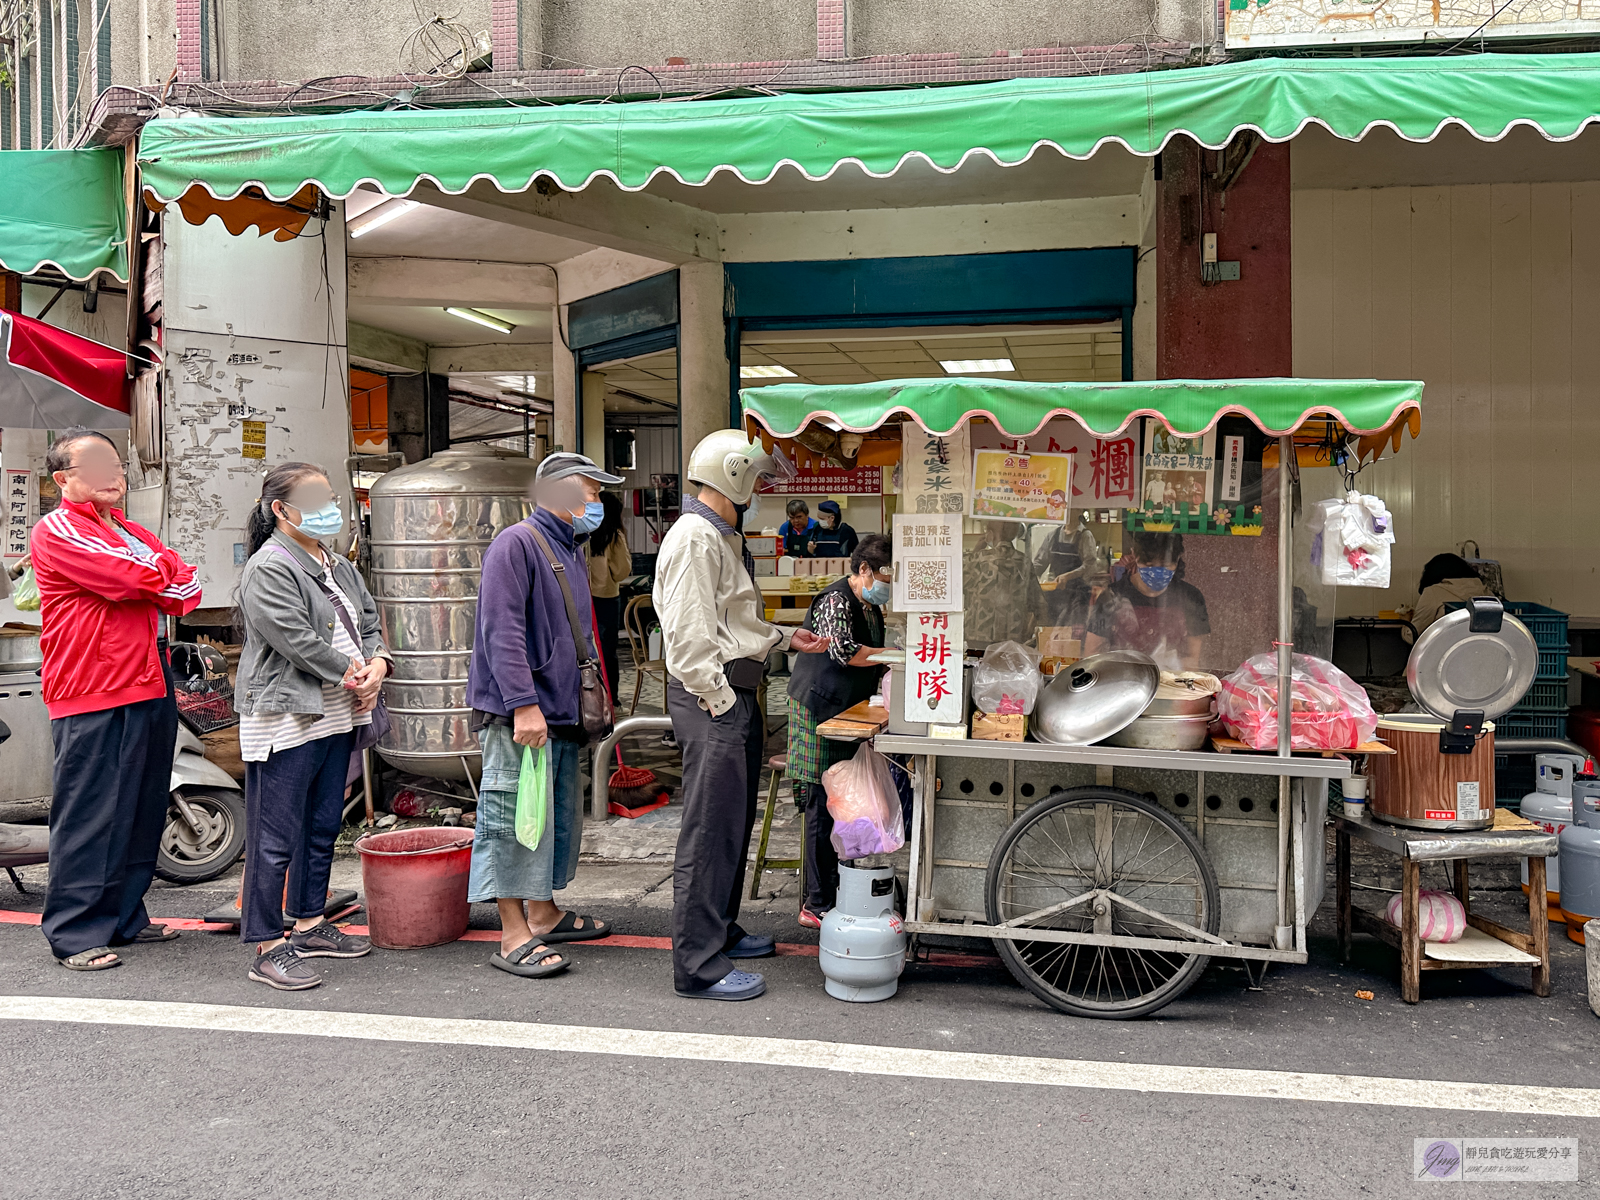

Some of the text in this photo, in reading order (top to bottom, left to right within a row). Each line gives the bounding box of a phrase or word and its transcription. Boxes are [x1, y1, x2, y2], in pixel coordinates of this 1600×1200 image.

[1004, 457, 1029, 468] 公告
[1144, 452, 1213, 470] 食尚玩家二度來訪
[10, 474, 28, 553] 南無阿彌陀佛
[902, 525, 950, 536] 歡迎預定
[902, 536, 952, 548] 請加LINE
